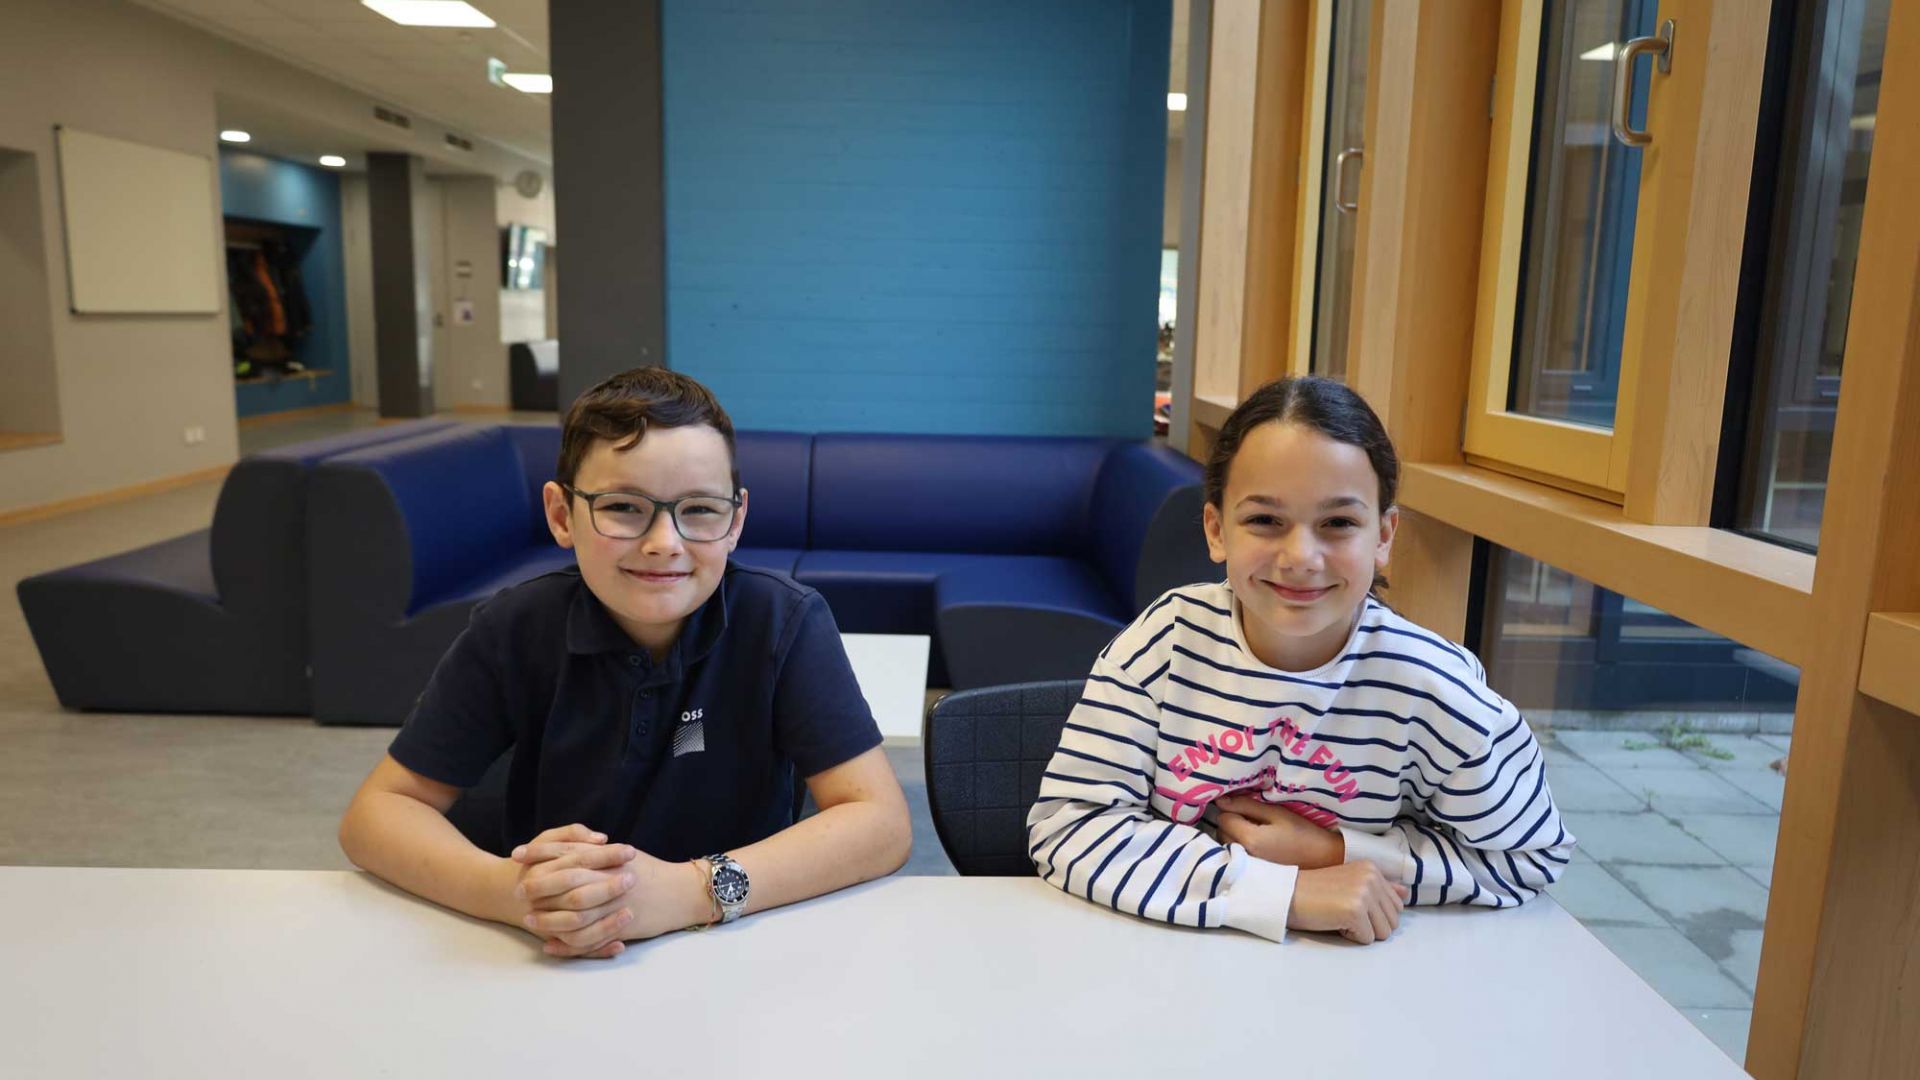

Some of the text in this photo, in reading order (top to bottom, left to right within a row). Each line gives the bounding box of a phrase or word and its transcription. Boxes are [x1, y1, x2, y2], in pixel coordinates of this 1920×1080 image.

[681, 708, 703, 722] OSS
[1168, 717, 1360, 803] ENJOY THE FUN
